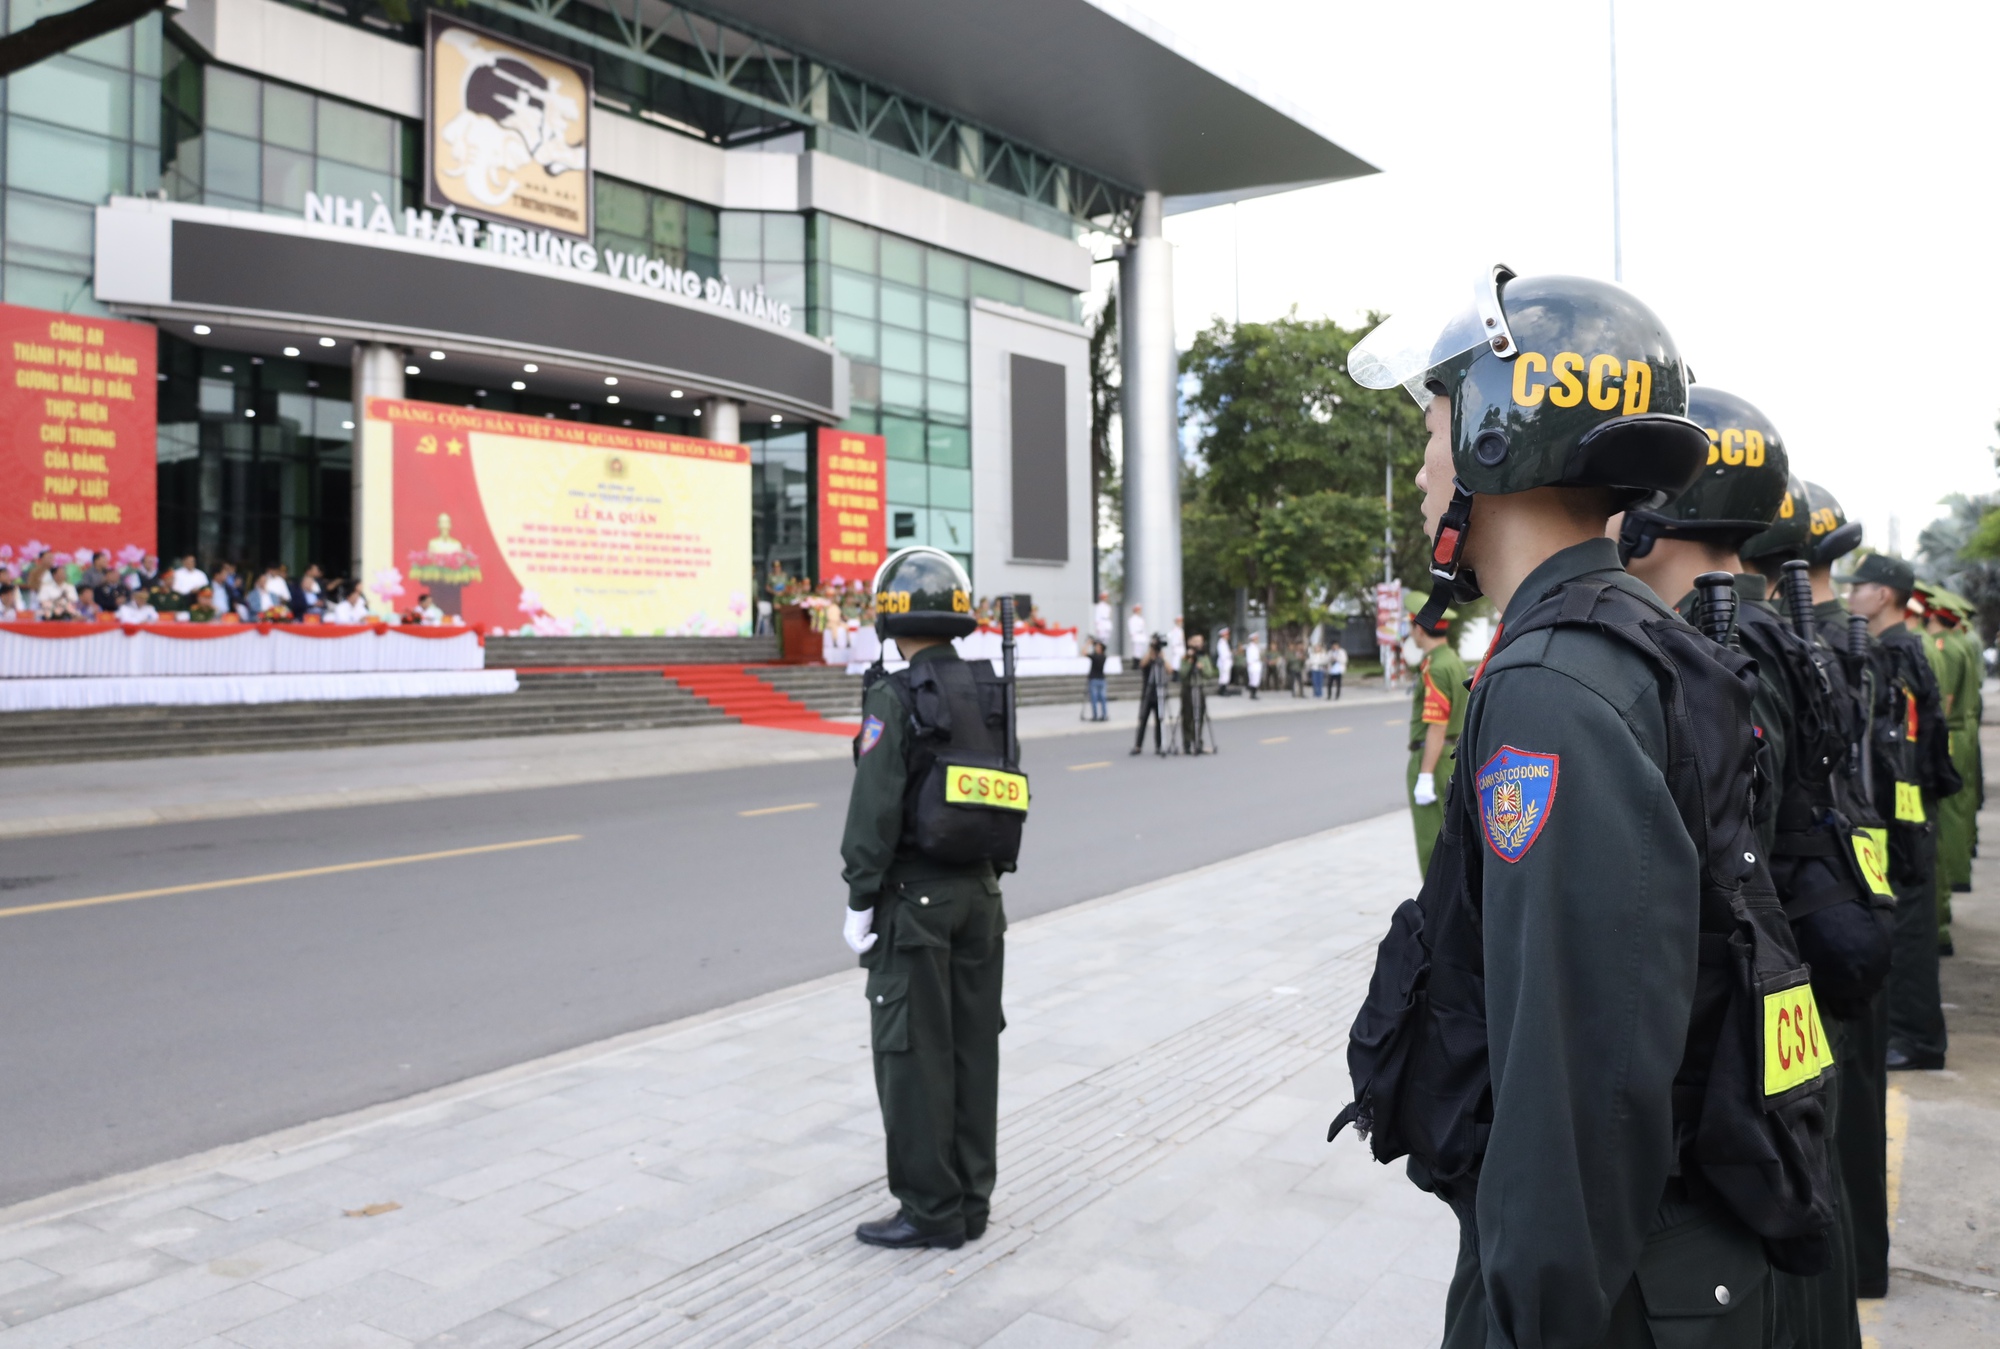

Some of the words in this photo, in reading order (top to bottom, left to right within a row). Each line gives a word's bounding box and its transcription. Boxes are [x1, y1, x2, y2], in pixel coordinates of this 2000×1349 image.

[304, 190, 397, 235] NHÀ
[404, 205, 480, 249] HÁT
[487, 222, 599, 272] TRƯNG
[604, 247, 702, 299] VƯƠNG
[703, 273, 736, 310] ĐÀ
[739, 283, 791, 327] NẴNG
[49, 319, 84, 343] CÔNG
[86, 327, 104, 346] AN
[1512, 351, 1653, 415] CSCĐ
[518, 421, 551, 439] VIỆT
[554, 426, 585, 441] NAM
[587, 431, 633, 447] QUANG
[1520, 764, 1549, 781] ĐỘNG
[957, 774, 1020, 801] CSCĐ
